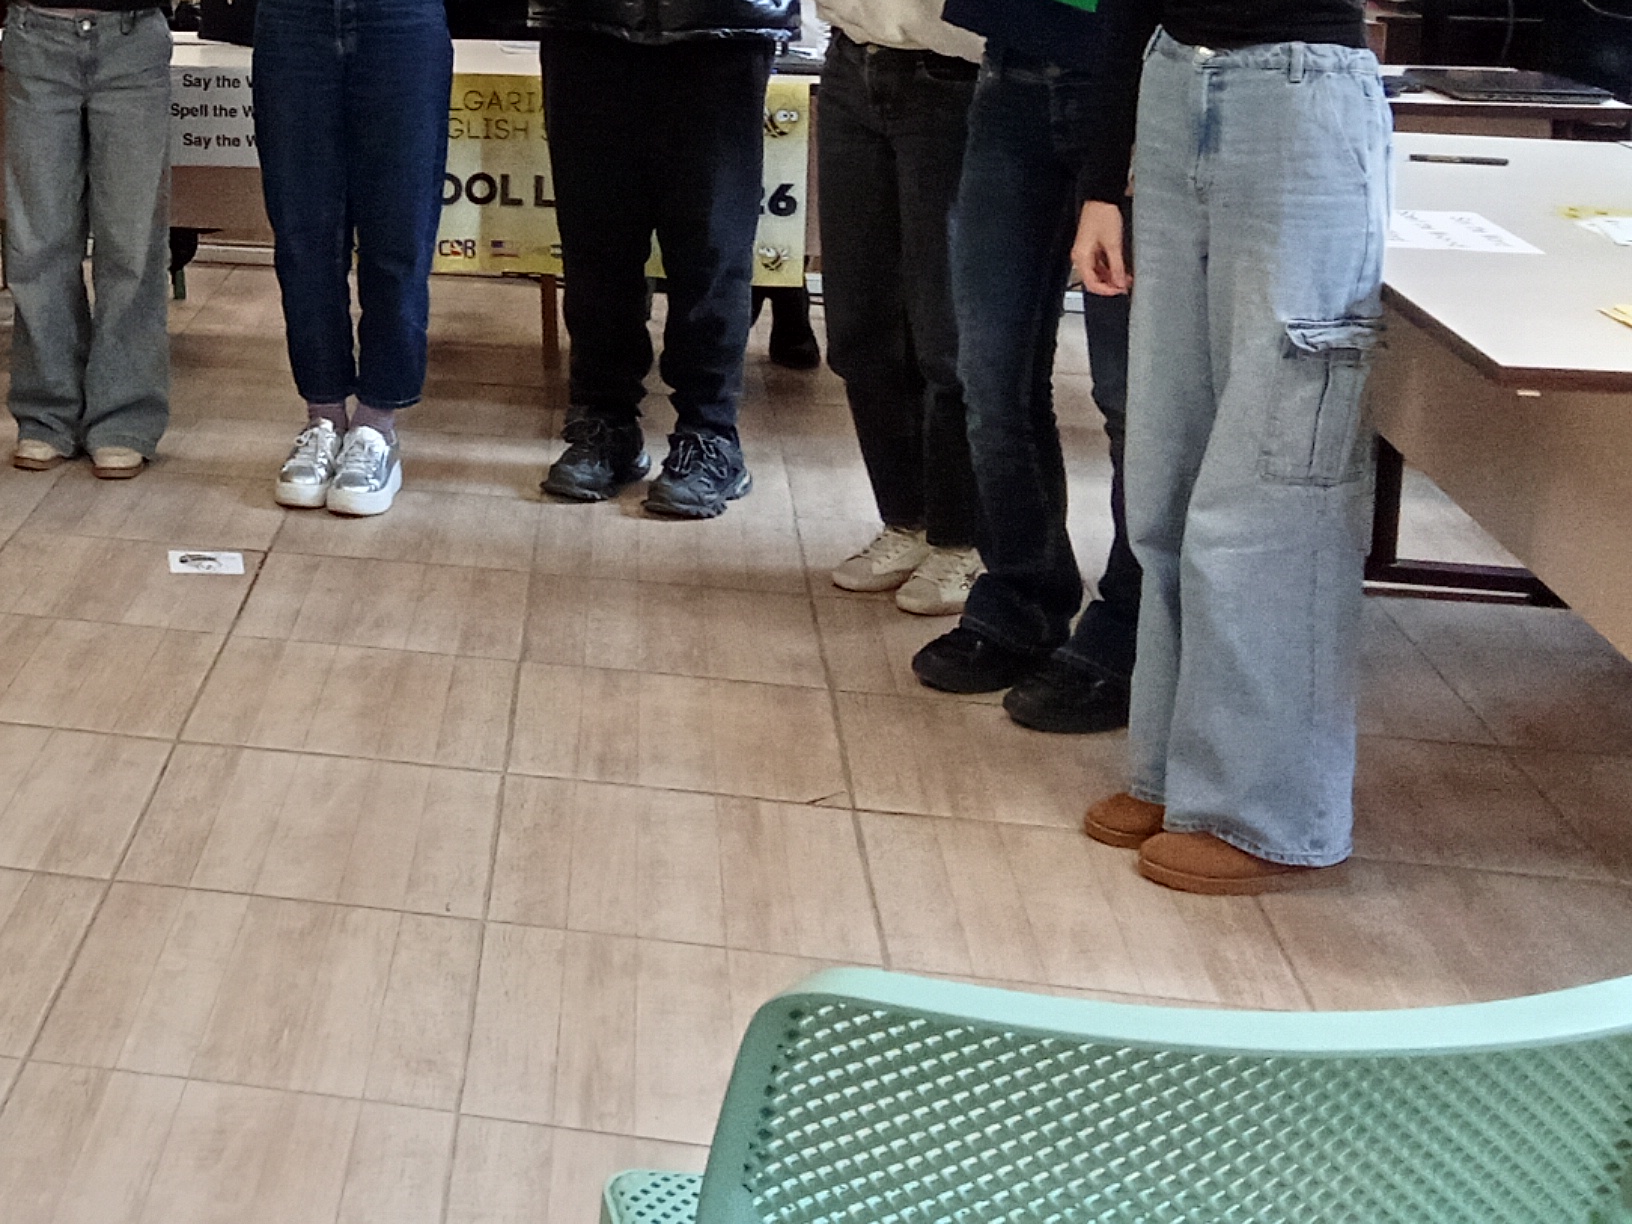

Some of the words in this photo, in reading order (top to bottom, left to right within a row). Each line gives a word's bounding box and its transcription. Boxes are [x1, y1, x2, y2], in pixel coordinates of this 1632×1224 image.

[182, 73, 212, 92] Say
[216, 75, 241, 88] the
[448, 89, 544, 113] GARI
[171, 102, 209, 120] Spell
[213, 104, 238, 118] the
[182, 132, 212, 150] Say
[216, 134, 241, 147] the
[760, 183, 798, 217] 6
